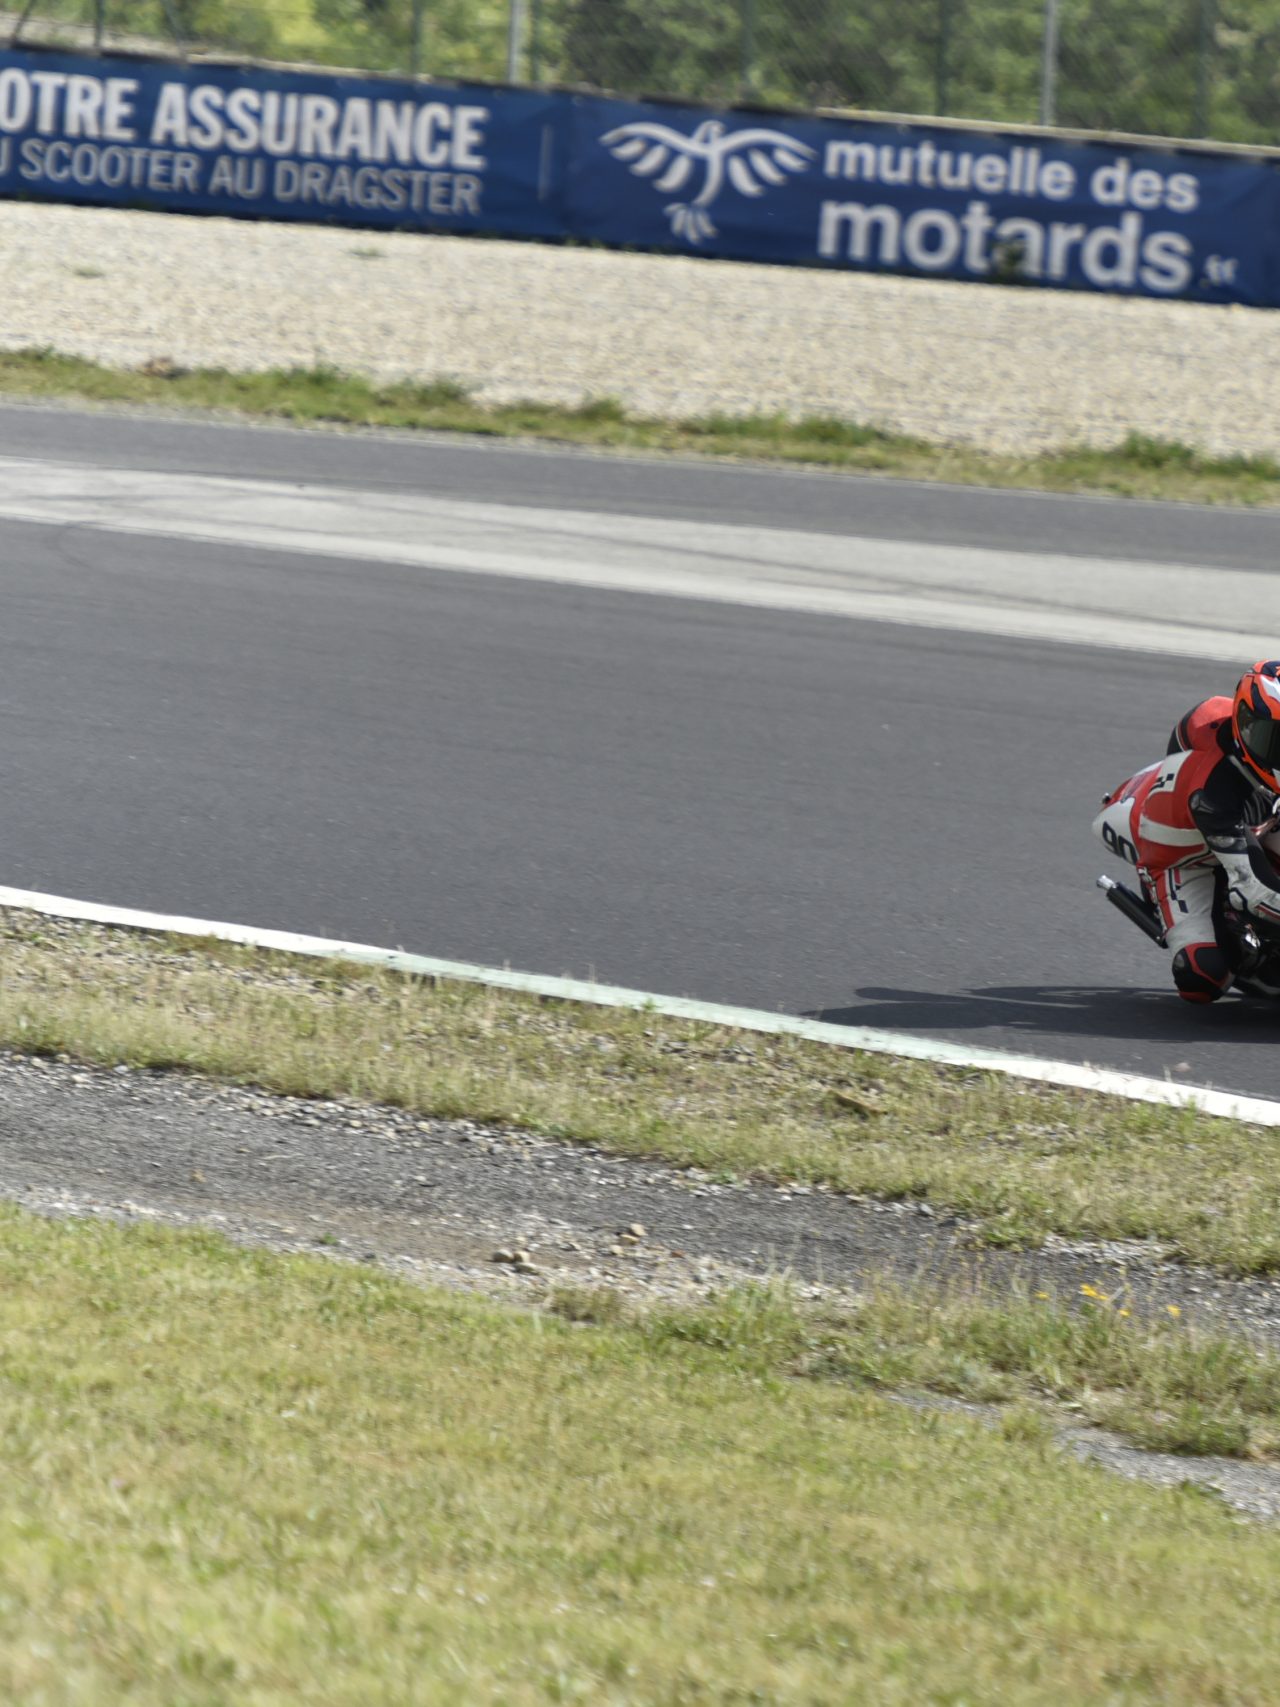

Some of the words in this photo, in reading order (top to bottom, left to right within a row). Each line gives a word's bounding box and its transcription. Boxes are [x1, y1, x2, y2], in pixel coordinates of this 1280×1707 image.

[151, 82, 490, 170] ASSURANCE
[19, 140, 200, 193] SCOOTER
[208, 155, 264, 199] AU
[273, 159, 483, 216] DRAGSTER
[824, 139, 1075, 201] mutuelle
[1091, 157, 1200, 213] des
